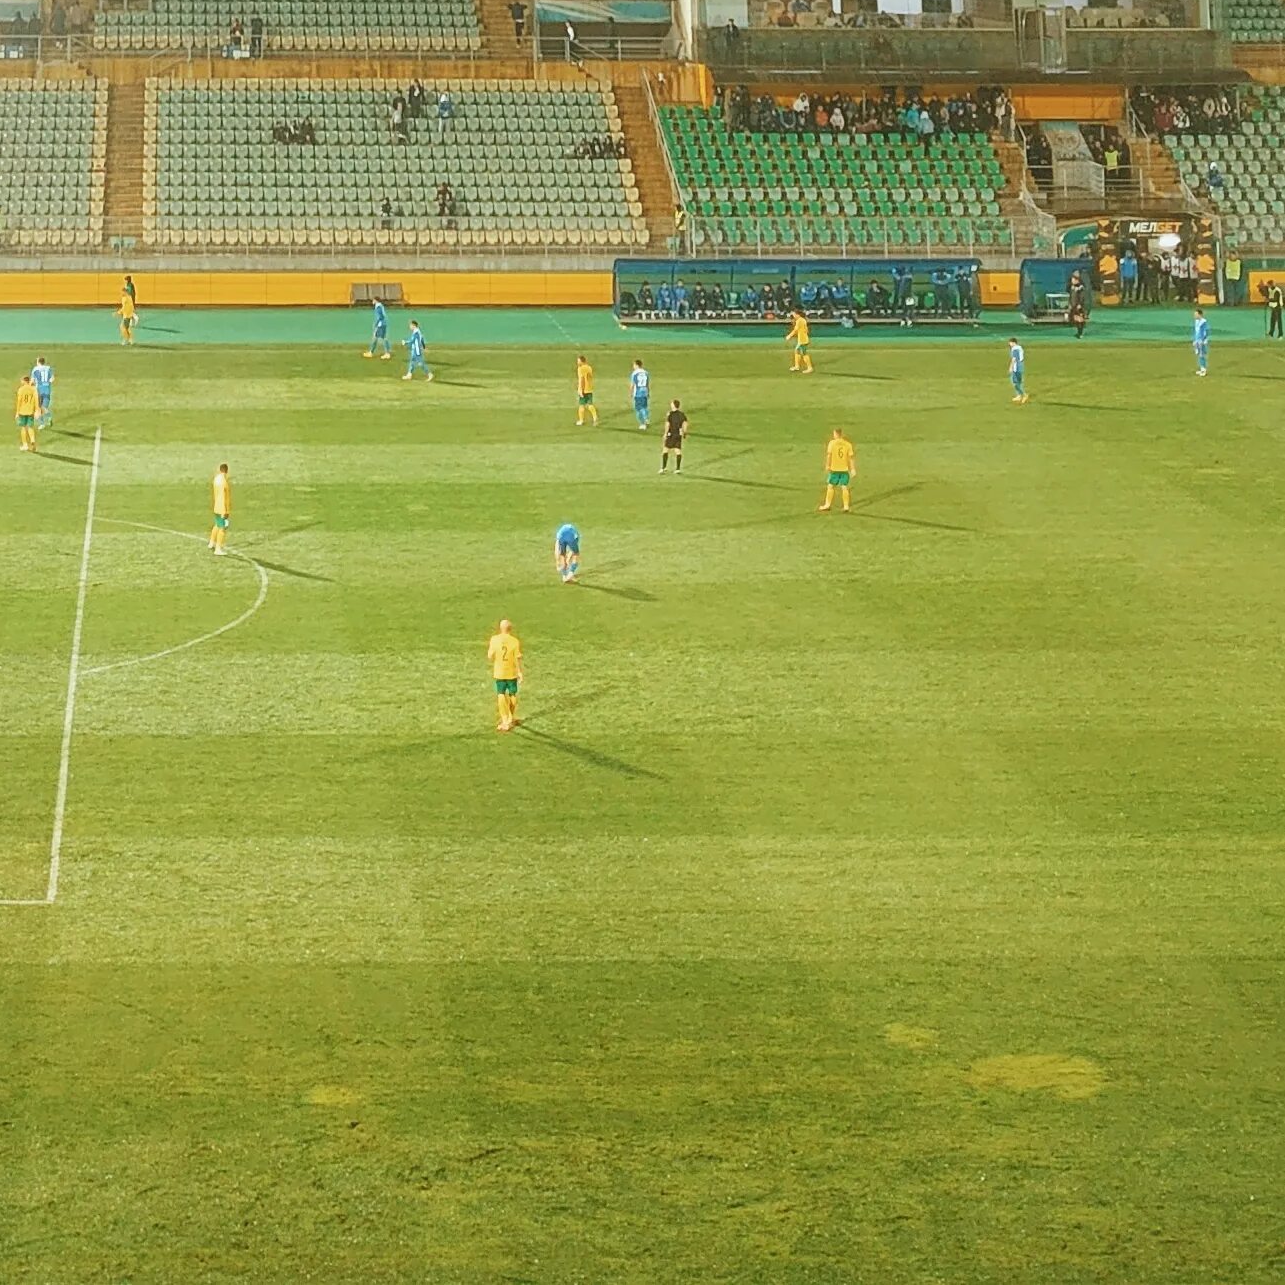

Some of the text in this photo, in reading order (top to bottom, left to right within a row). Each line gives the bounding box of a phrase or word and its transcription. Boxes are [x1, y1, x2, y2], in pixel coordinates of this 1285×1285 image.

[1128, 221, 1183, 234] МЕЛБЕТ
[838, 446, 844, 459] 6
[501, 645, 509, 662] 2
